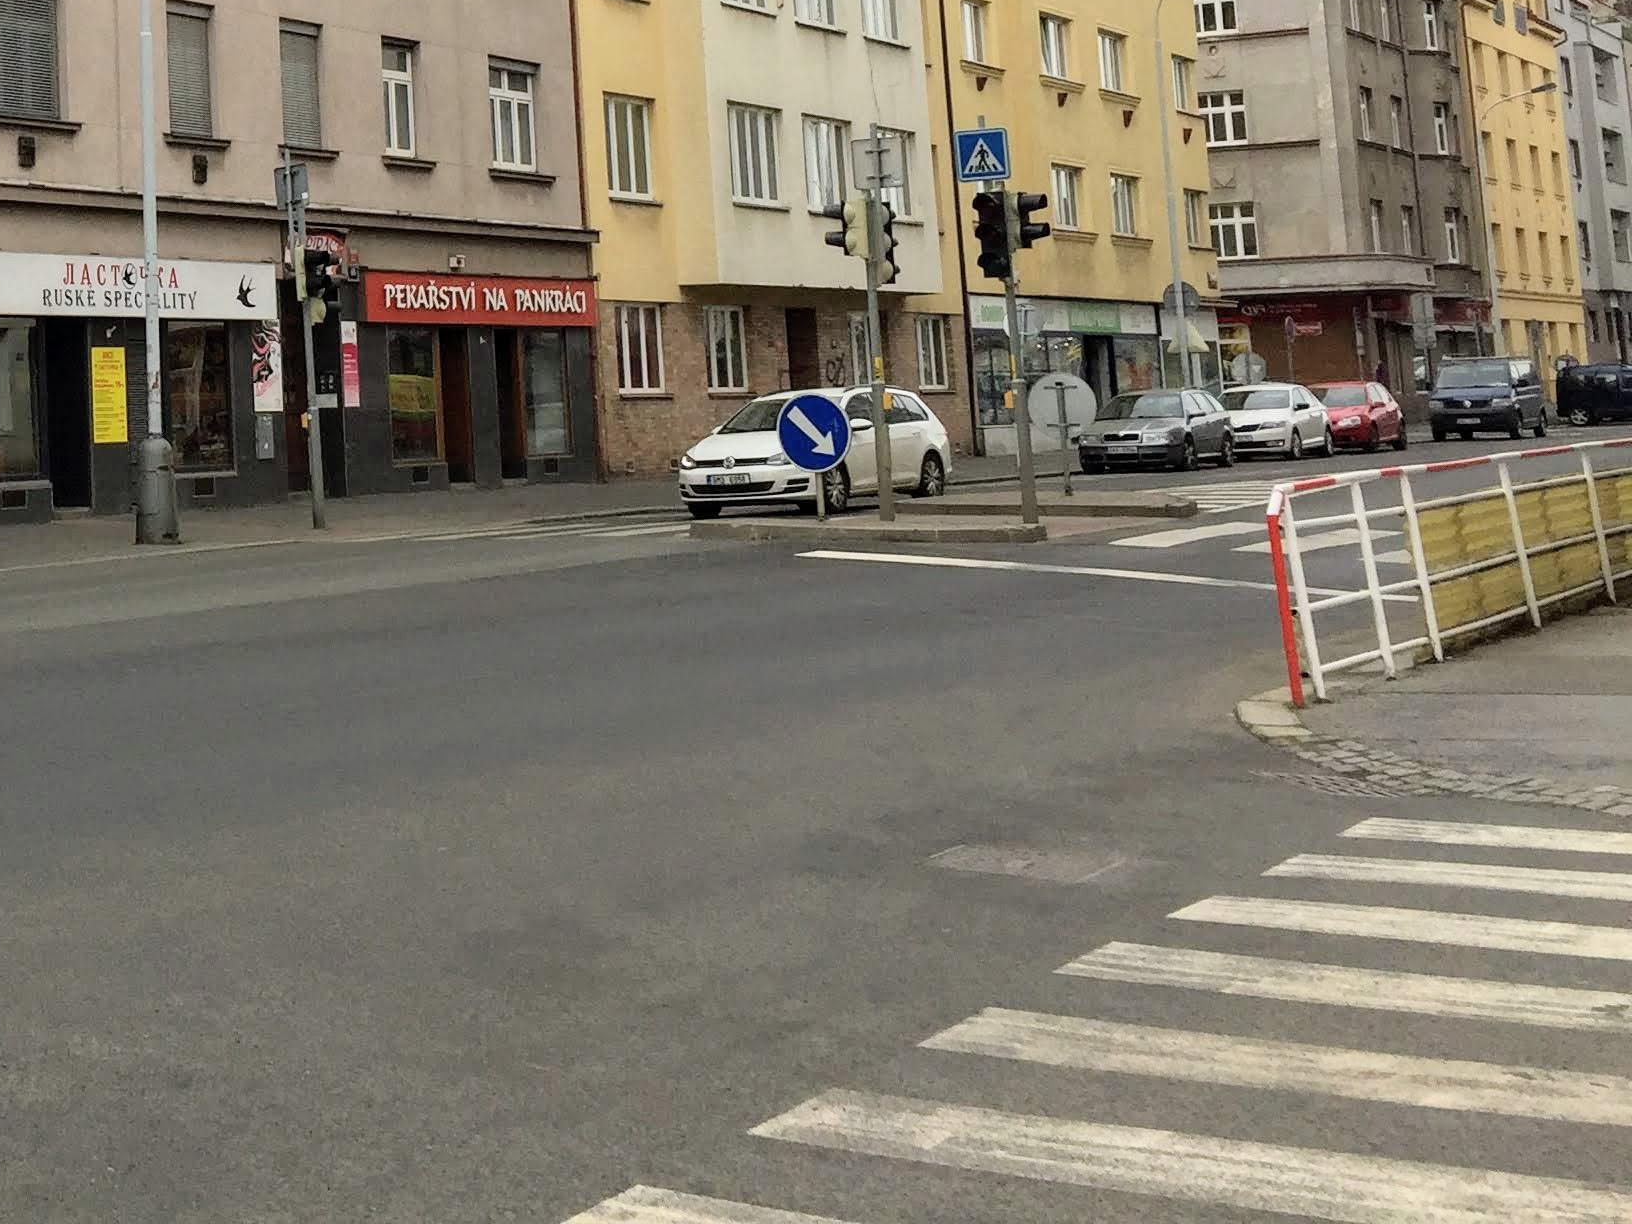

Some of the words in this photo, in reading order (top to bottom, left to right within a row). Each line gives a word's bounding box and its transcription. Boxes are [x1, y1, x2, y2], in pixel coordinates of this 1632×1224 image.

[103, 290, 197, 310] SPECLITY
[384, 280, 476, 310] PEKAŘSTVÍ
[482, 287, 508, 311] NA
[515, 285, 586, 313] PANKRÁCI
